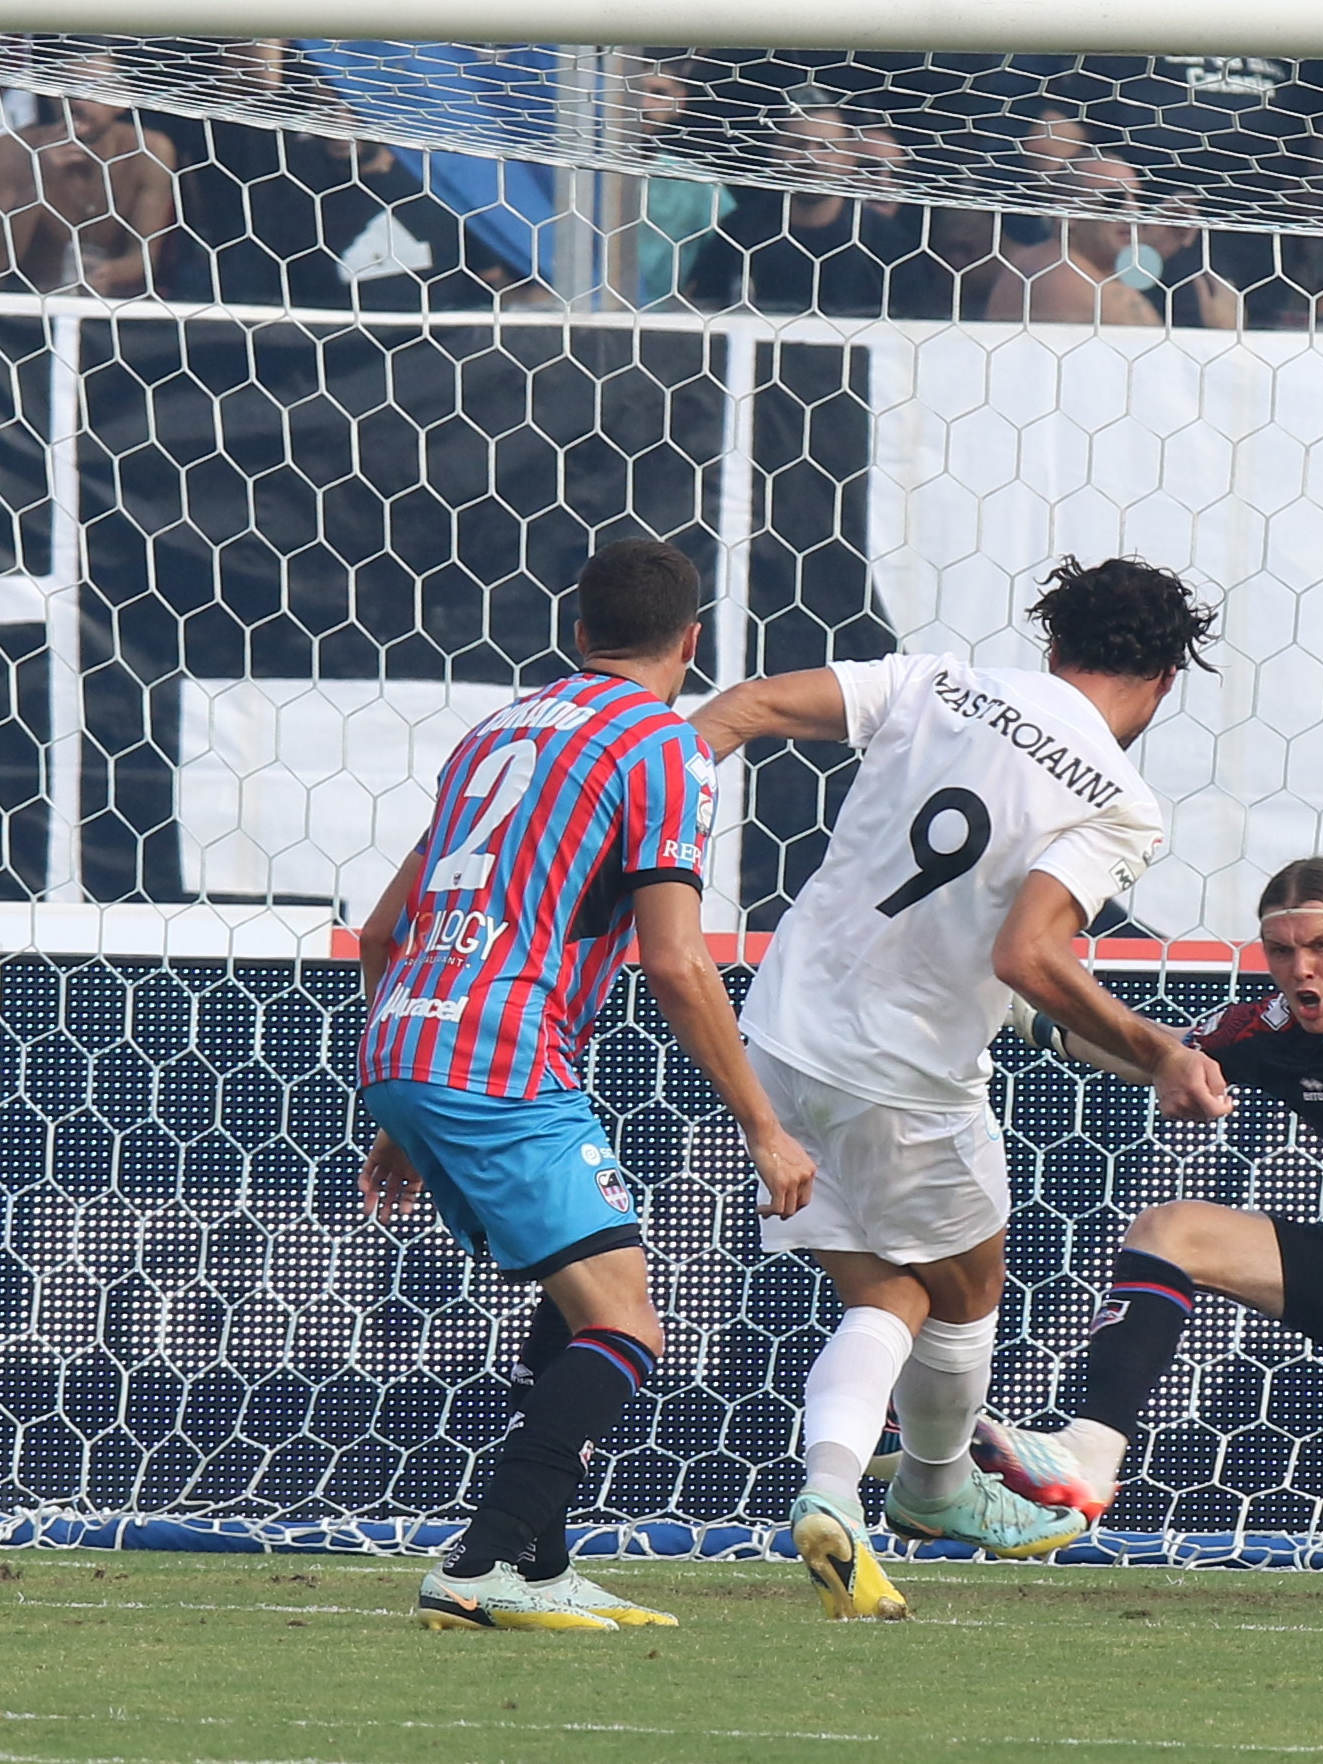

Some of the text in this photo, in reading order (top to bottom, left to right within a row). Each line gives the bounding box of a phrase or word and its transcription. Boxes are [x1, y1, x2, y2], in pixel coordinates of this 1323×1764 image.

[932, 669, 1125, 809] MASTROIANNI
[427, 738, 537, 892] 2
[875, 786, 992, 919] 9
